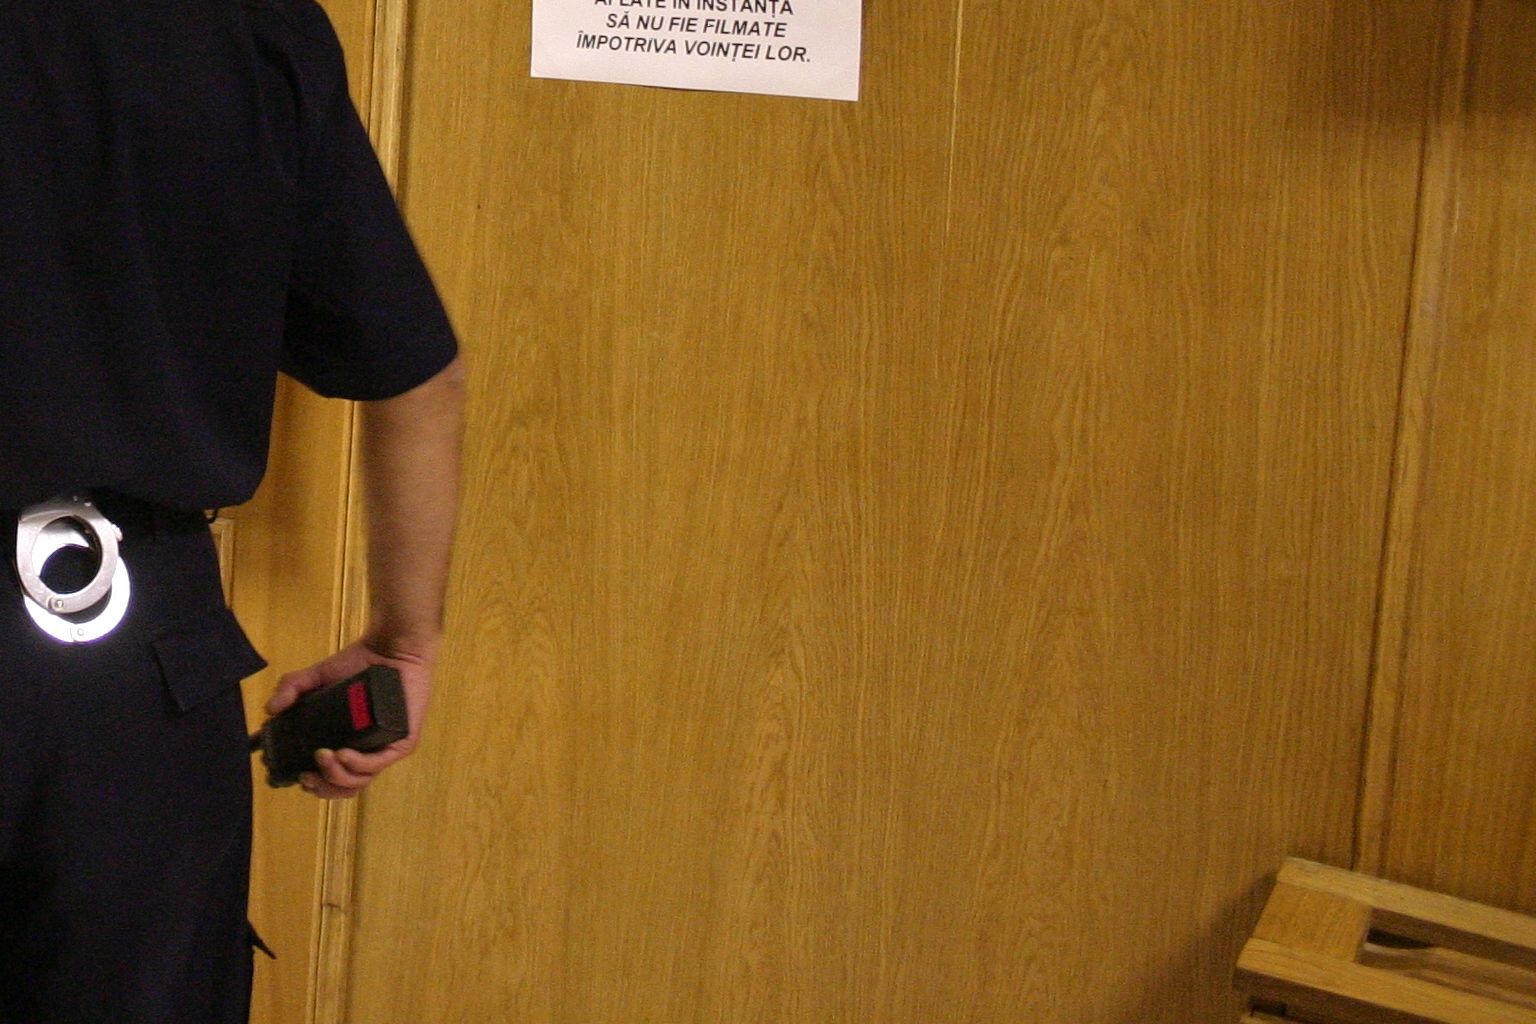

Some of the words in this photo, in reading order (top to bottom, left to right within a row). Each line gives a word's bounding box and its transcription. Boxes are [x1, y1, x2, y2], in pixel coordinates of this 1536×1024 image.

[606, 11, 630, 29] SĂ
[636, 15, 664, 31] NU
[668, 17, 699, 33] FIE
[703, 18, 788, 38] FILMATE
[576, 30, 677, 54] ÎMPOTRIVA
[765, 45, 811, 63] LOR.
